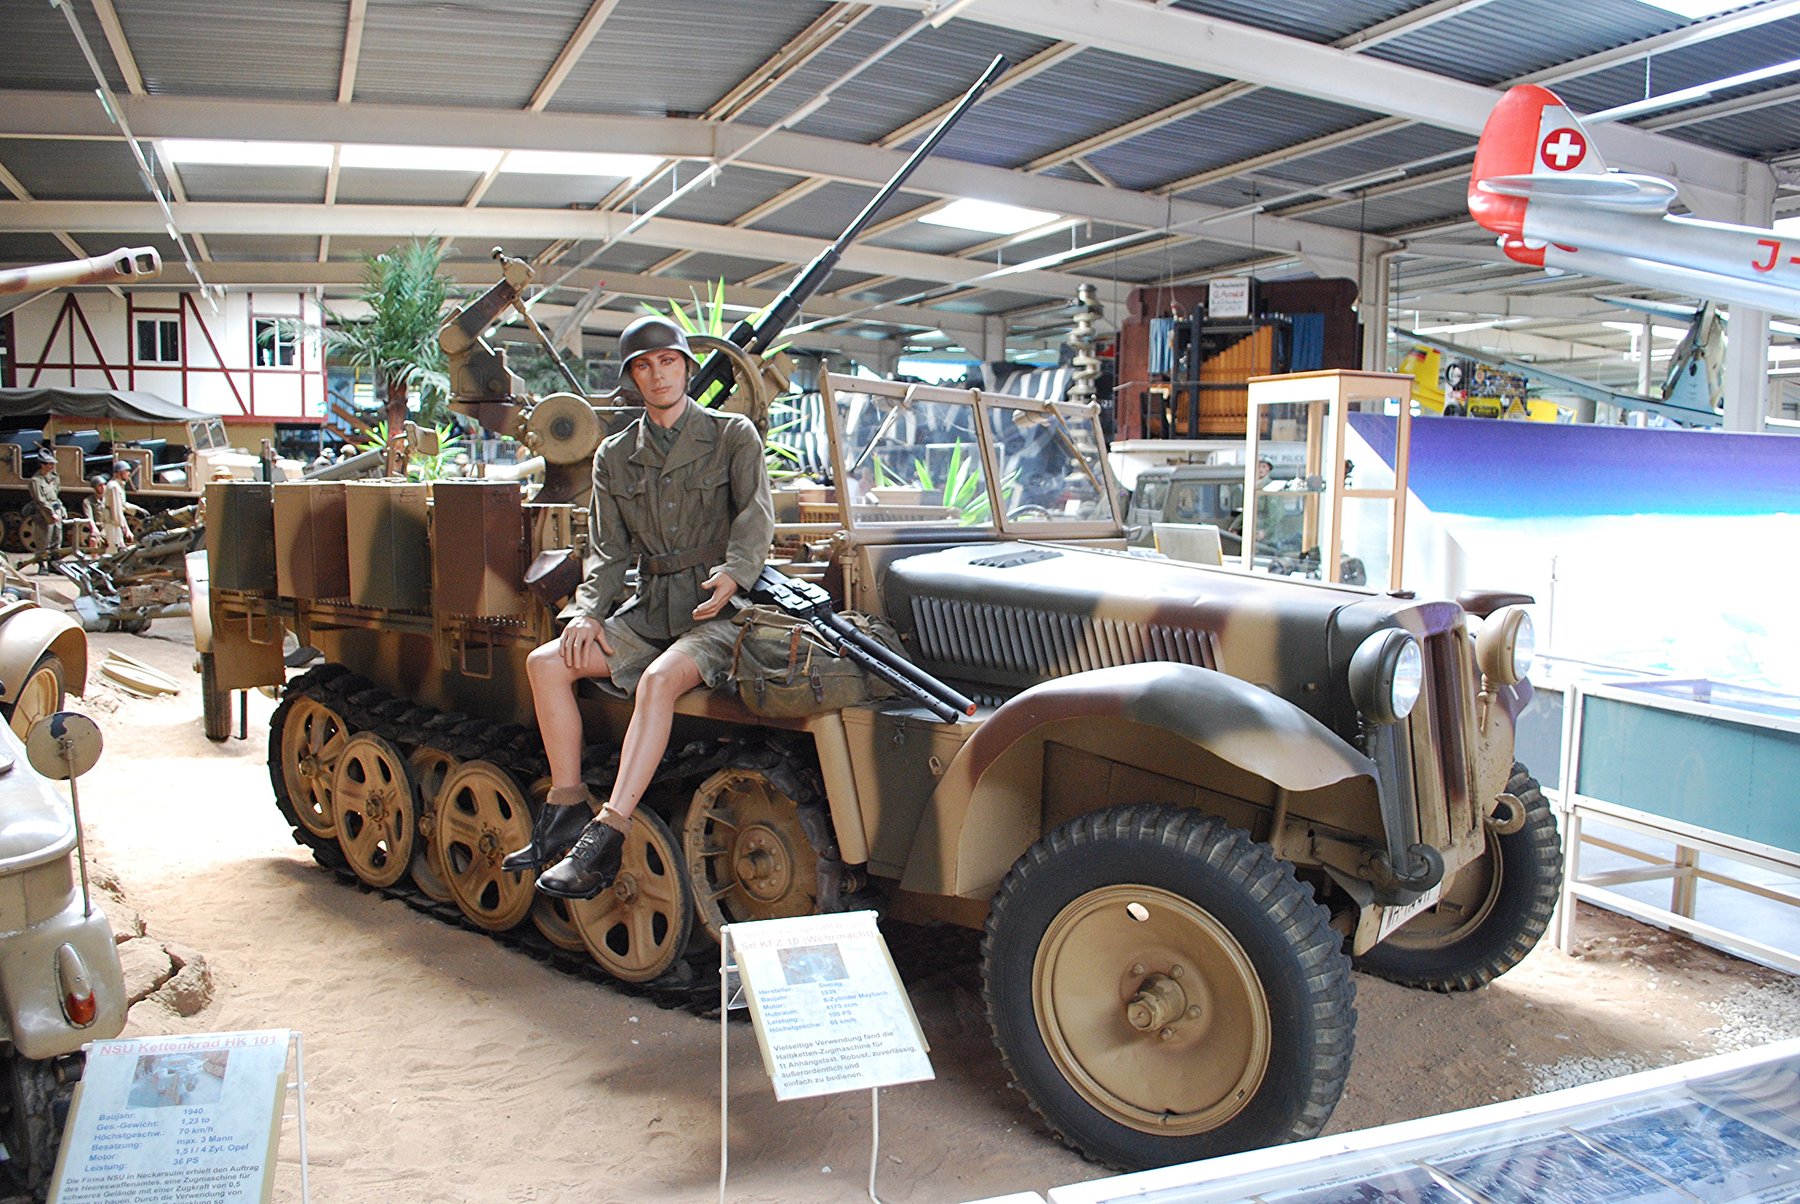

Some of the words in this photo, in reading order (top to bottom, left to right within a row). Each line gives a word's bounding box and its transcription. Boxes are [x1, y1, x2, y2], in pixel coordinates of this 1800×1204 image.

[100, 1044, 133, 1056] NSU
[139, 1040, 220, 1052] Kettenkrad
[225, 1037, 247, 1047] HK
[253, 1035, 277, 1045] 101
[773, 1042, 814, 1052] Vielseitige
[815, 1036, 862, 1046] Verwendung
[776, 1044, 871, 1060] Halbketten-Zugmaschine
[844, 1062, 860, 1070] und
[783, 1078, 813, 1088] einfach
[826, 1071, 864, 1082] bedienen.
[98, 1113, 136, 1121] Baujahr:
[183, 1107, 204, 1115] 1940
[96, 1121, 159, 1131] Ges.-Gewicht:
[181, 1117, 199, 1126] 1,23
[191, 1126, 214, 1134] km/h
[91, 1142, 143, 1151] Besatzung:
[208, 1145, 225, 1154] Zyl.
[228, 1143, 249, 1152] Opel
[84, 1163, 127, 1172] Leistung:
[173, 1158, 184, 1166] 36
[186, 1156, 199, 1164] PS
[106, 1174, 124, 1182] NSU
[136, 1171, 184, 1179] Neckarsulm
[229, 1164, 259, 1172] Auftrag
[183, 1174, 237, 1184] Zugmaschine
[62, 1193, 101, 1201] schweres
[103, 1189, 137, 1197] Gelände
[176, 1183, 210, 1192] Zugkraft
[134, 1194, 159, 1203] Durch
[175, 1190, 225, 1200] Verwendung
